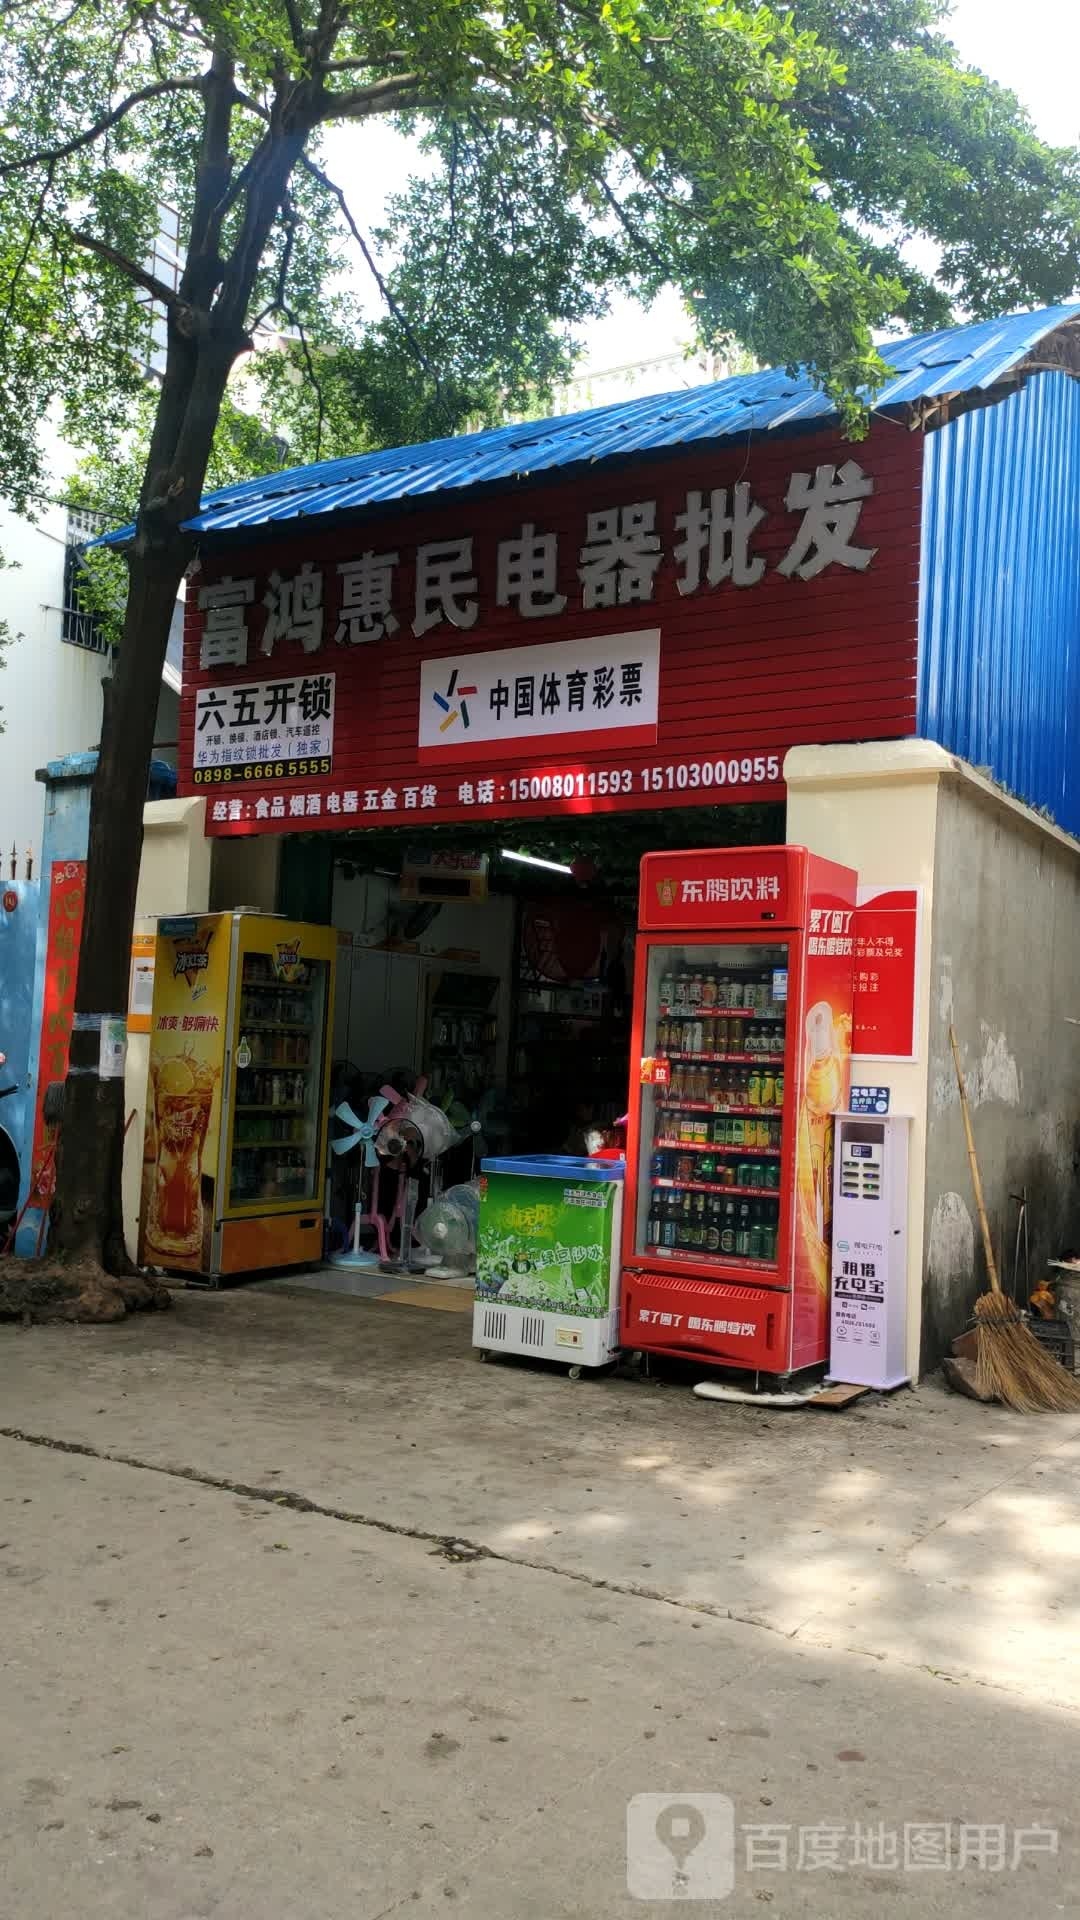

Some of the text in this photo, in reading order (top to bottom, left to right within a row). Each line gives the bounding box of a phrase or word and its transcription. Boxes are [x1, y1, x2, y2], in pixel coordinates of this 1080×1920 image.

[198, 460, 879, 671] 富鸿惠民电器批发
[489, 662, 643, 720] 中国体育彩票
[197, 676, 332, 731] 六五开锁
[289, 793, 321, 817] 烟酒
[327, 791, 358, 814] 电器
[362, 788, 398, 811] 五金
[402, 784, 438, 809] 百货
[641, 756, 779, 791] 15103000955
[681, 876, 780, 903] 东鹏饮料
[808, 909, 854, 933] 累了困了
[808, 936, 853, 956] 喝东鹏特饮
[854, 936, 894, 947] 年人不得
[854, 948, 904, 958] 彩票及兑奖
[842, 1261, 876, 1277] 租借
[834, 1277, 884, 1294] 充电宝
[638, 1309, 684, 1328] 累了困了
